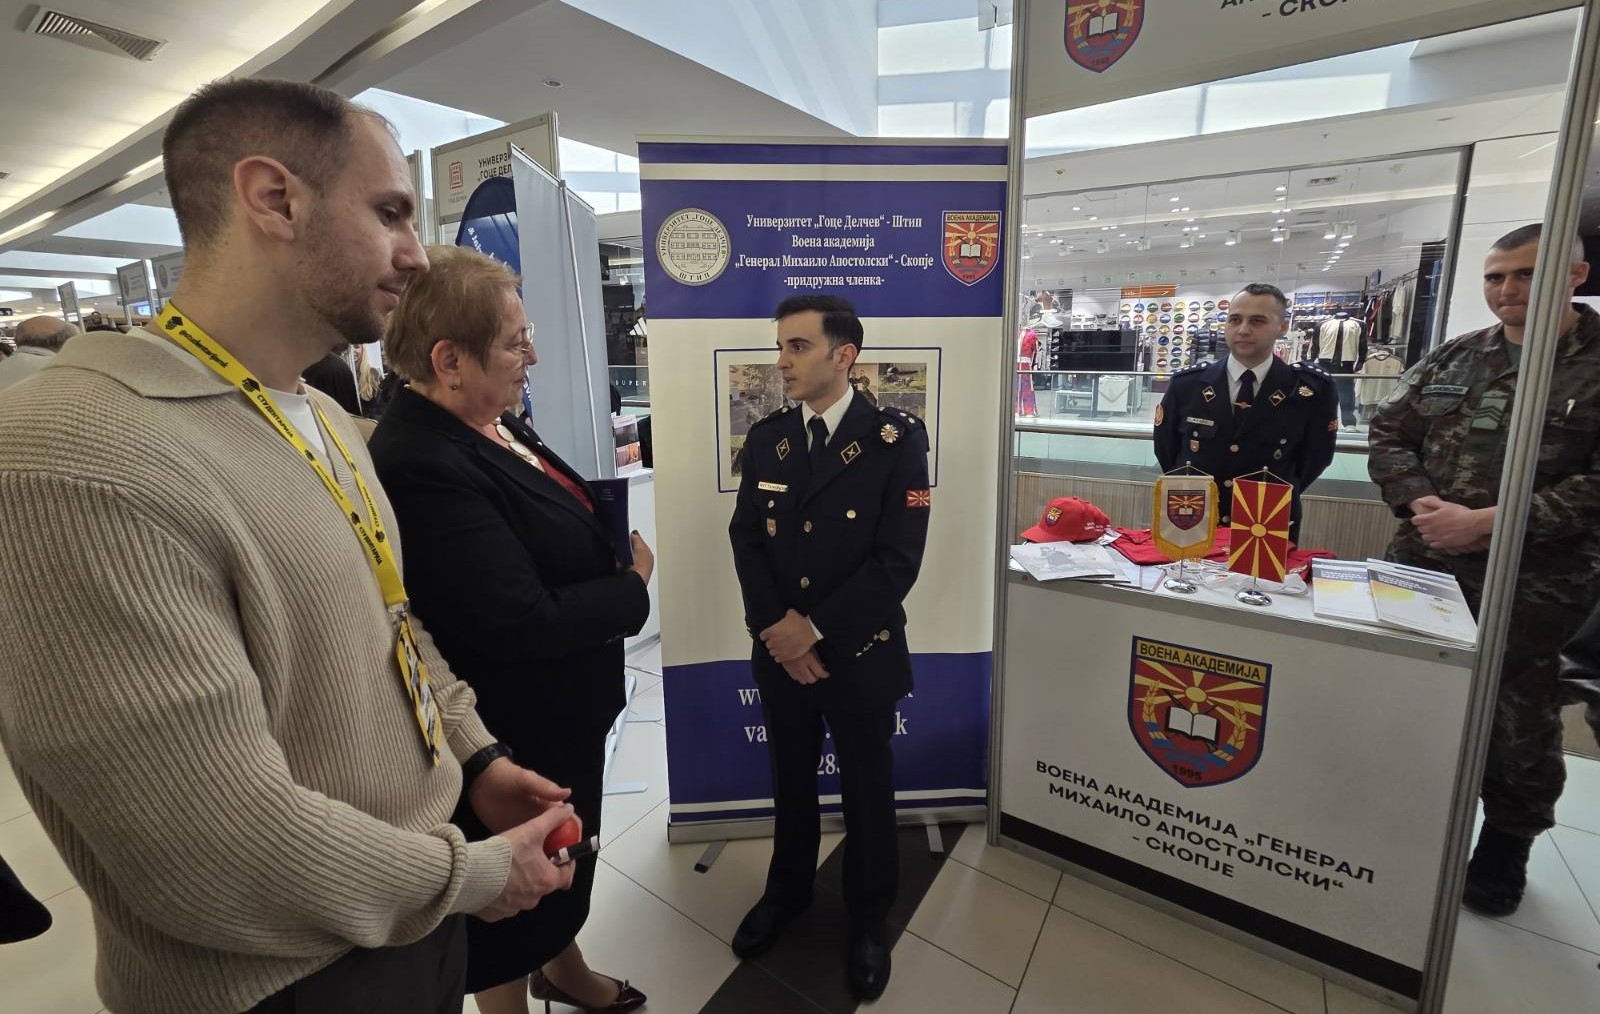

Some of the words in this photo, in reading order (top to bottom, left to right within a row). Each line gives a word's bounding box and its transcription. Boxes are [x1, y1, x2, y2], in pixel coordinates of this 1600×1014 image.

[746, 215, 812, 231] Универзитет
[814, 215, 843, 229] „Гоце
[844, 215, 884, 230] Делчев“
[892, 215, 922, 228] Штип
[792, 234, 821, 247] Воена
[823, 234, 875, 250] академија
[735, 255, 780, 270] „Генерал
[782, 254, 828, 267] Михаило
[829, 254, 893, 267] Апостолски“
[900, 253, 934, 269] Скопје
[784, 275, 844, 289] -придружна
[846, 275, 885, 286] членка-
[1140, 643, 1180, 662] ВОЕНА
[1183, 653, 1261, 680] АКАДЕМИЈА
[1172, 764, 1202, 781] 1995
[1036, 760, 1099, 792] ВОЕНА
[1104, 784, 1238, 839] АКАДЕМИЈА
[1244, 832, 1375, 884] „ГЕНЕРАЛ
[1049, 783, 1151, 828] МИХАИЛО
[1156, 820, 1344, 891] АПОСТОЛСКИ“
[1145, 837, 1235, 879] СКОПЈЕ
